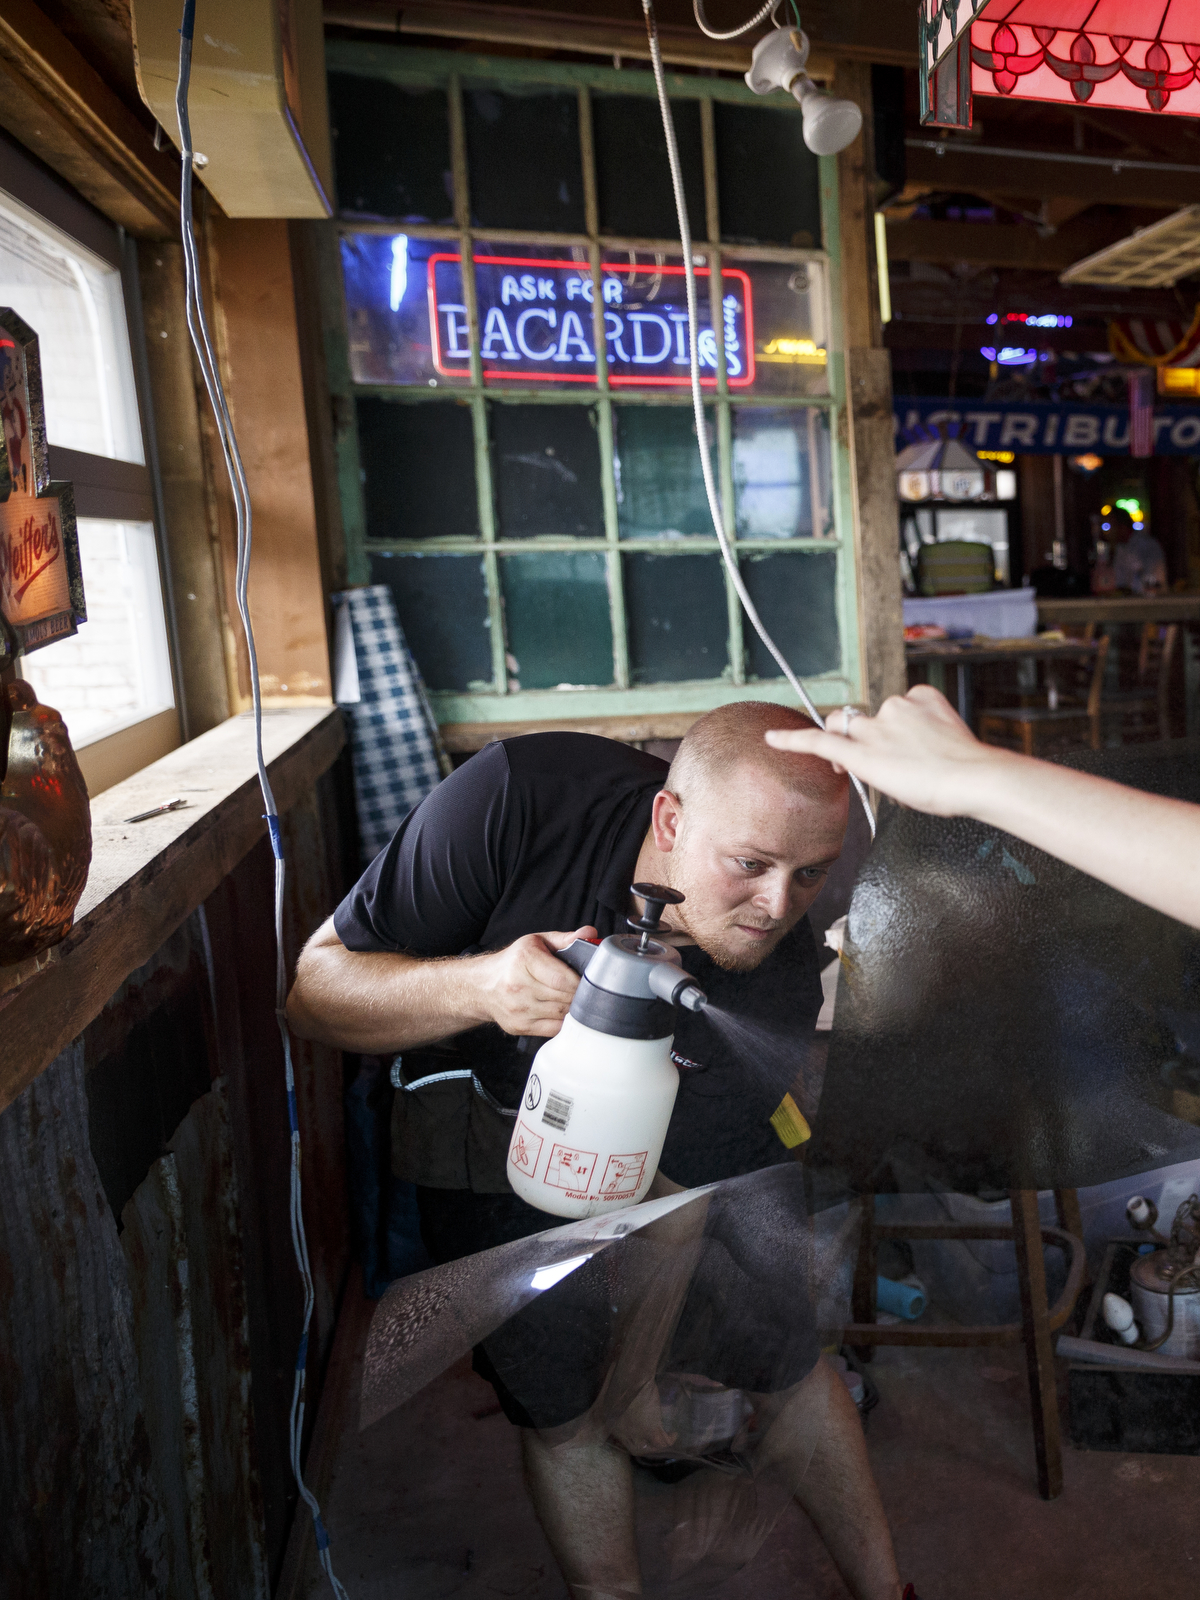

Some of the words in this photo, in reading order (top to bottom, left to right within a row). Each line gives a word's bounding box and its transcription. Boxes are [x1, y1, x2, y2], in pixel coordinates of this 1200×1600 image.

[502, 274, 557, 304] ASK
[565, 276, 623, 303] FOR
[437, 303, 692, 365] BACARDI
[50, 614, 70, 635] BEER
[565, 1191, 588, 1201] Model
